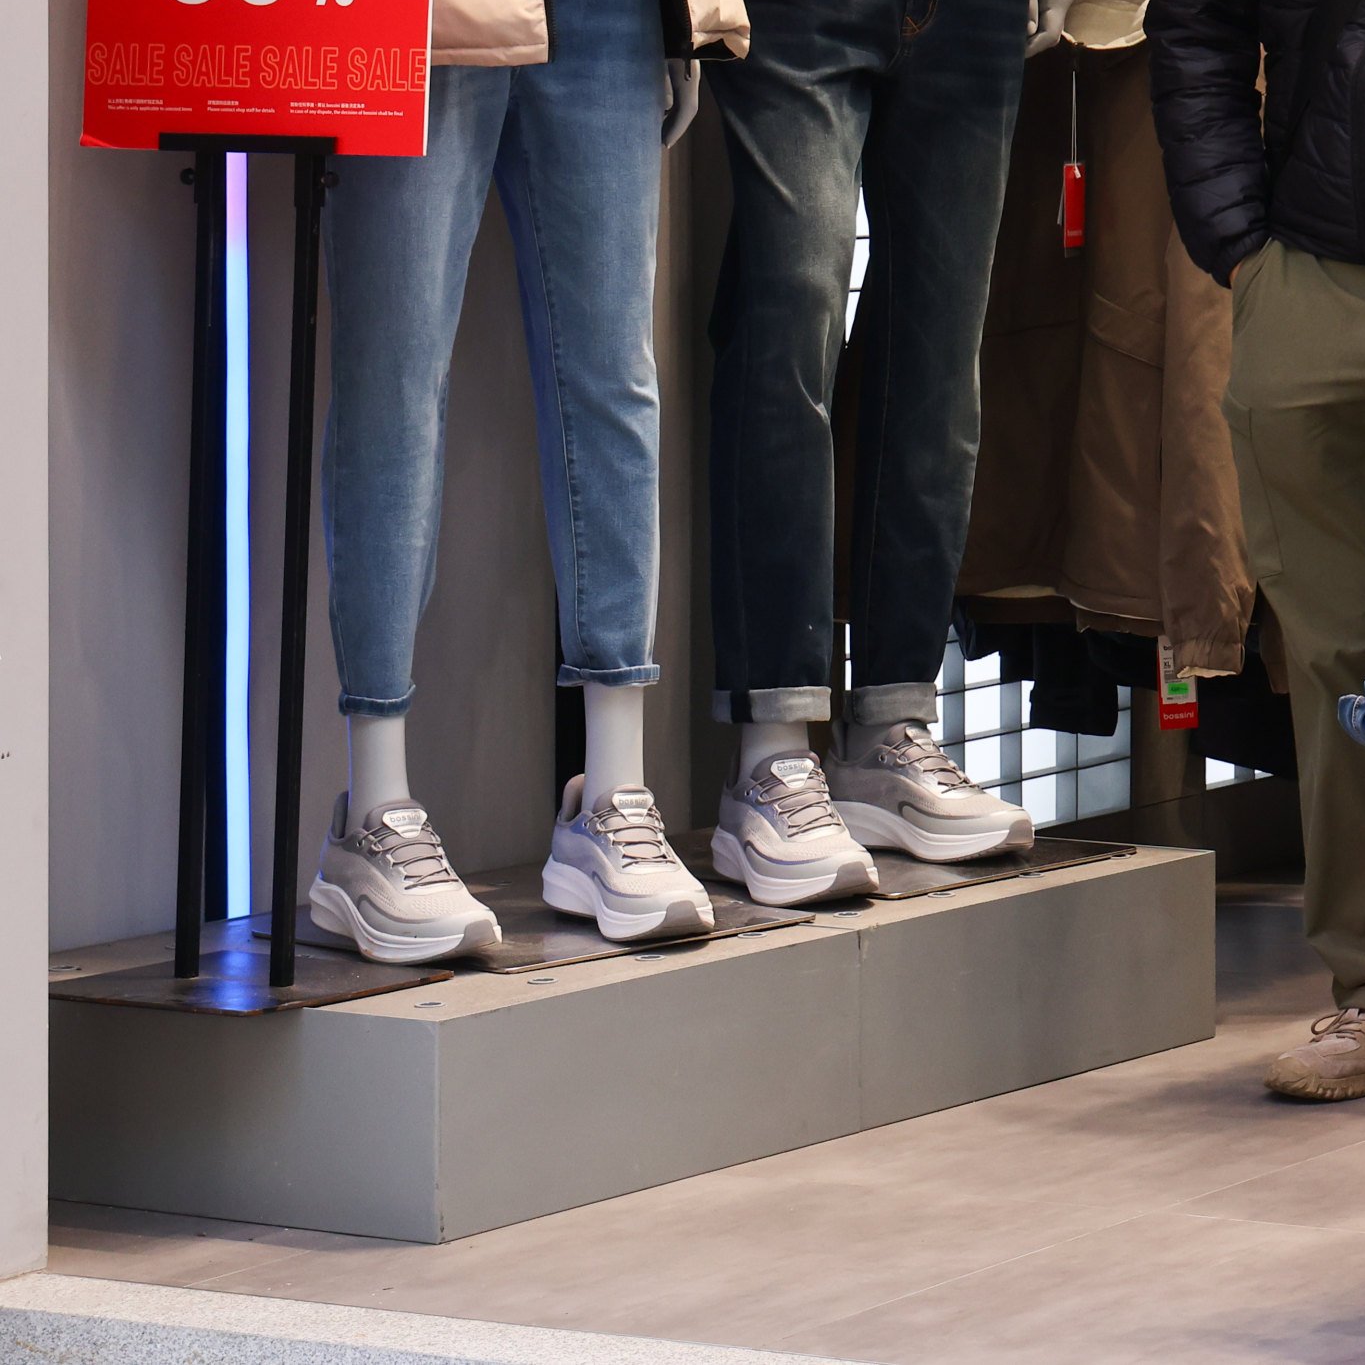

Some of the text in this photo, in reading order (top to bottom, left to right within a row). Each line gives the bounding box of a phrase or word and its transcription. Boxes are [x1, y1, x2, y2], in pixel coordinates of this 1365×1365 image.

[88, 43, 426, 92] SALE SALE SALE SALE
[1163, 711, 1194, 720] bossini
[390, 812, 421, 822] bossini
